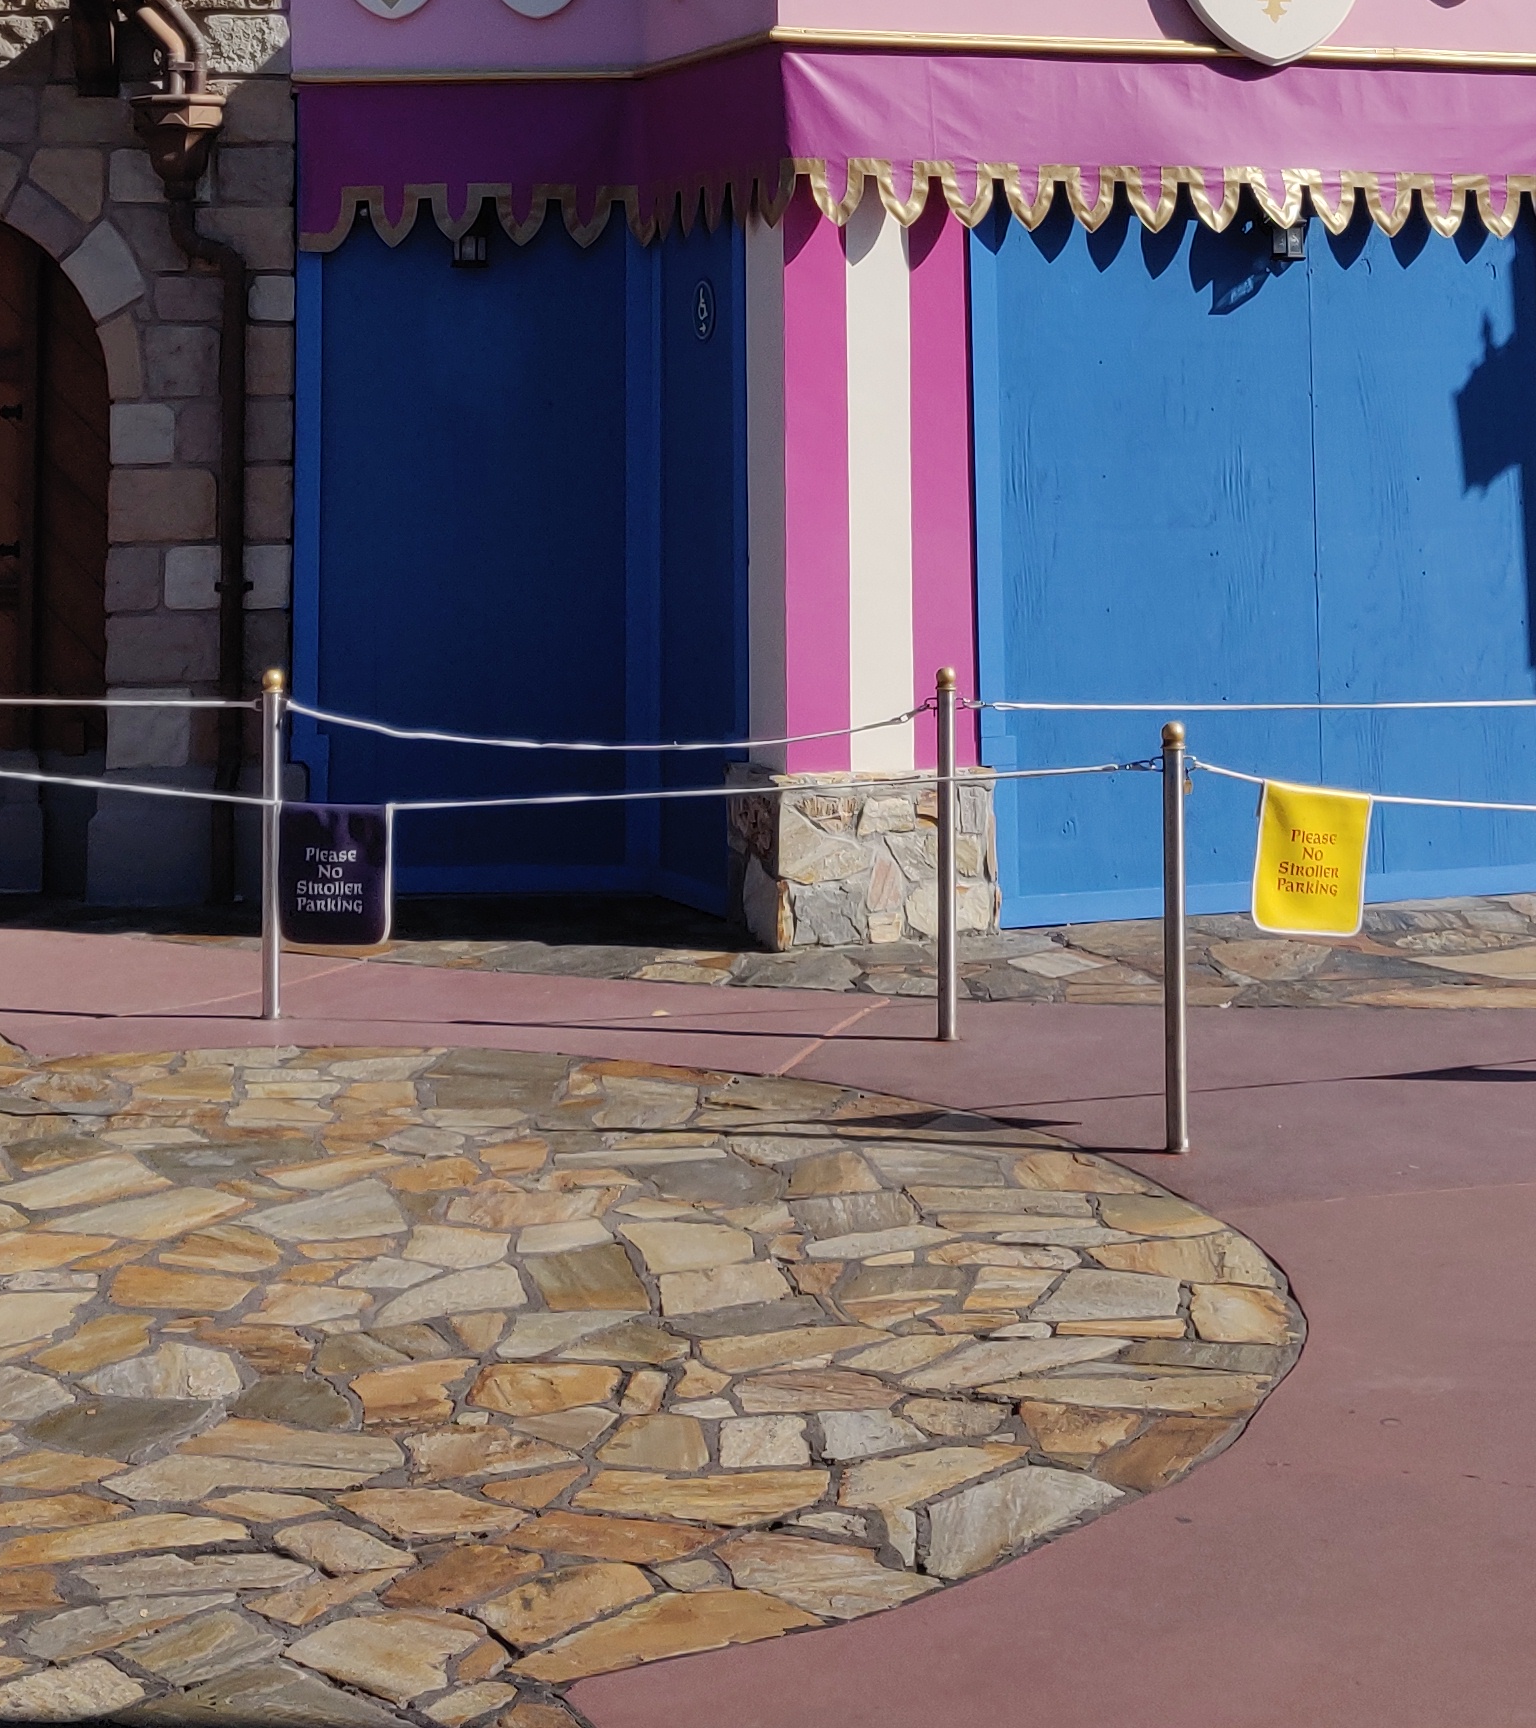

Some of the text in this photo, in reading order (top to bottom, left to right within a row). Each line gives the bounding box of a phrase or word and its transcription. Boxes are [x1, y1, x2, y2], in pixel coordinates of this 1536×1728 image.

[1290, 829, 1337, 845] Please
[305, 847, 357, 862] Please
[1278, 861, 1339, 879] Stroller
[296, 880, 363, 896] Stroller
[1277, 877, 1338, 898] Parking
[296, 896, 363, 914] Parking
